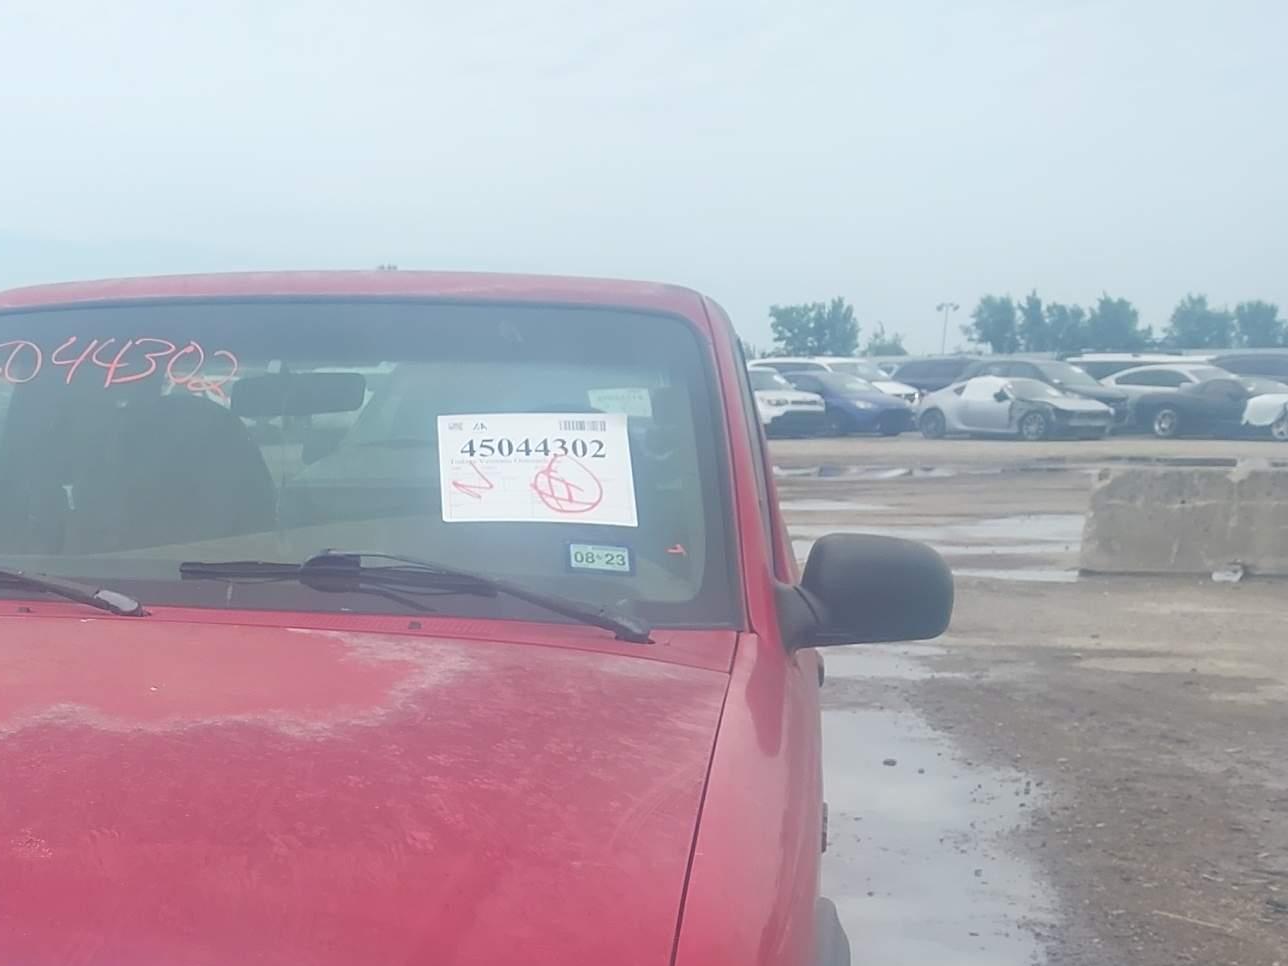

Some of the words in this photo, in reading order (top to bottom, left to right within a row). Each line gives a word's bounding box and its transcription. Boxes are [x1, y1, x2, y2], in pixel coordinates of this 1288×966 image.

[460, 437, 607, 458] 45044302
[574, 551, 595, 564] 08
[605, 553, 626, 566] 23
